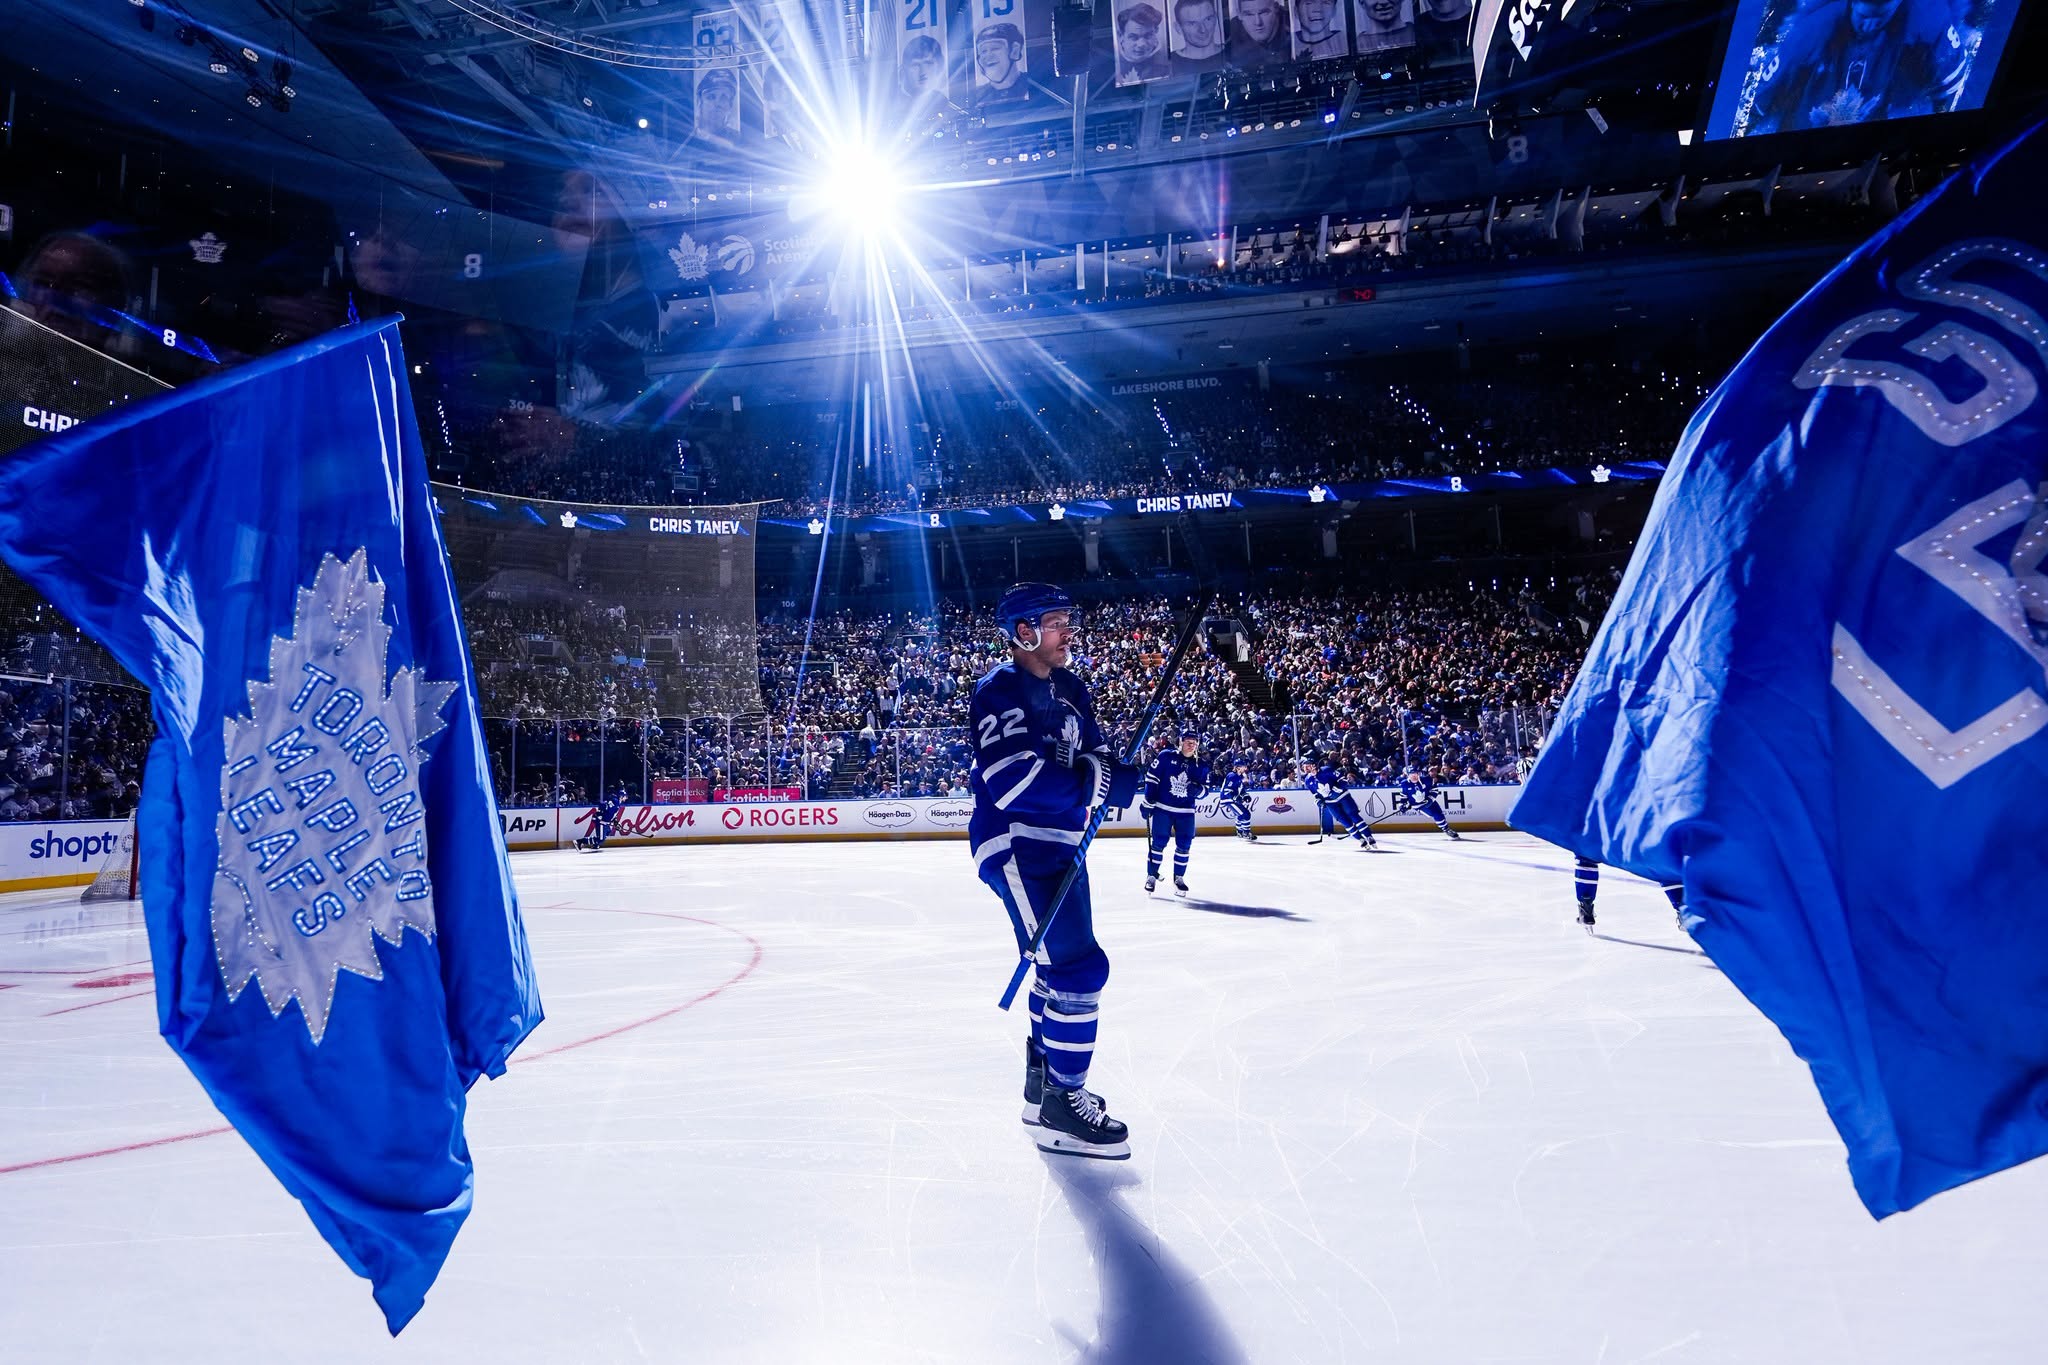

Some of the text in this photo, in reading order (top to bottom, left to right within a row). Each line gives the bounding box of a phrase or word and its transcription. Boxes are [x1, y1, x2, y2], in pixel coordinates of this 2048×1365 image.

[464, 254, 482, 278] 8
[163, 329, 176, 347] 8
[1111, 377, 1222, 396] LAKESHORE BLVD.
[508, 399, 534, 412] 306
[23, 406, 86, 433] CHR
[1451, 477, 1462, 491] 8
[1137, 492, 1233, 513] CHRIS TANEV
[650, 517, 740, 535] CHRIS TANEV
[930, 513, 940, 527] 8
[782, 600, 796, 608] 106
[978, 707, 1028, 750] 22
[290, 662, 430, 902] TORONTO
[656, 788, 682, 797] Scotia
[723, 790, 791, 802] Scotiabank
[266, 725, 392, 903] MAPLE
[750, 807, 838, 826] ROGERS
